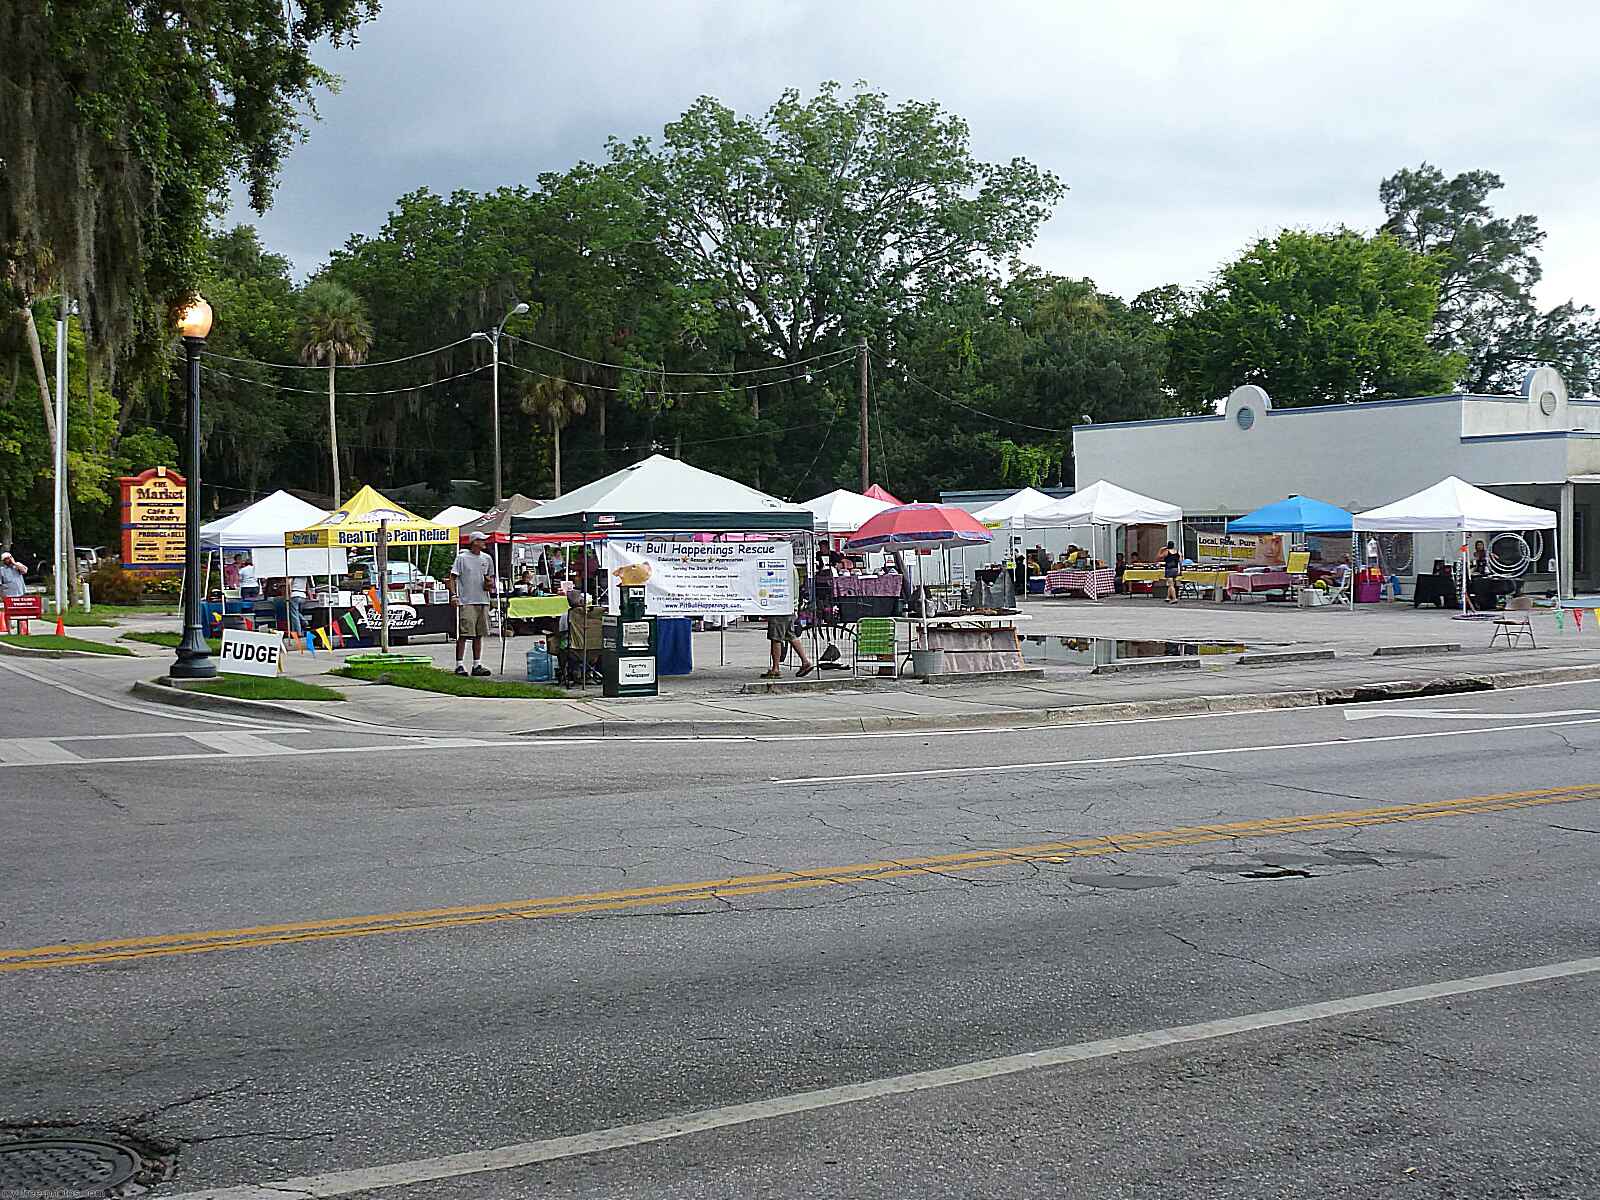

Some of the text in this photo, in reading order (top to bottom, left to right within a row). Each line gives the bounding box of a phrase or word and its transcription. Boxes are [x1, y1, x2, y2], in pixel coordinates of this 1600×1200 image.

[136, 488, 185, 500] Market
[338, 530, 364, 544] Real
[394, 529, 418, 542] Pain
[419, 528, 450, 541] Relief
[625, 542, 775, 557] Pit Bull Happenings Rescue
[222, 641, 278, 664] FUDGE
